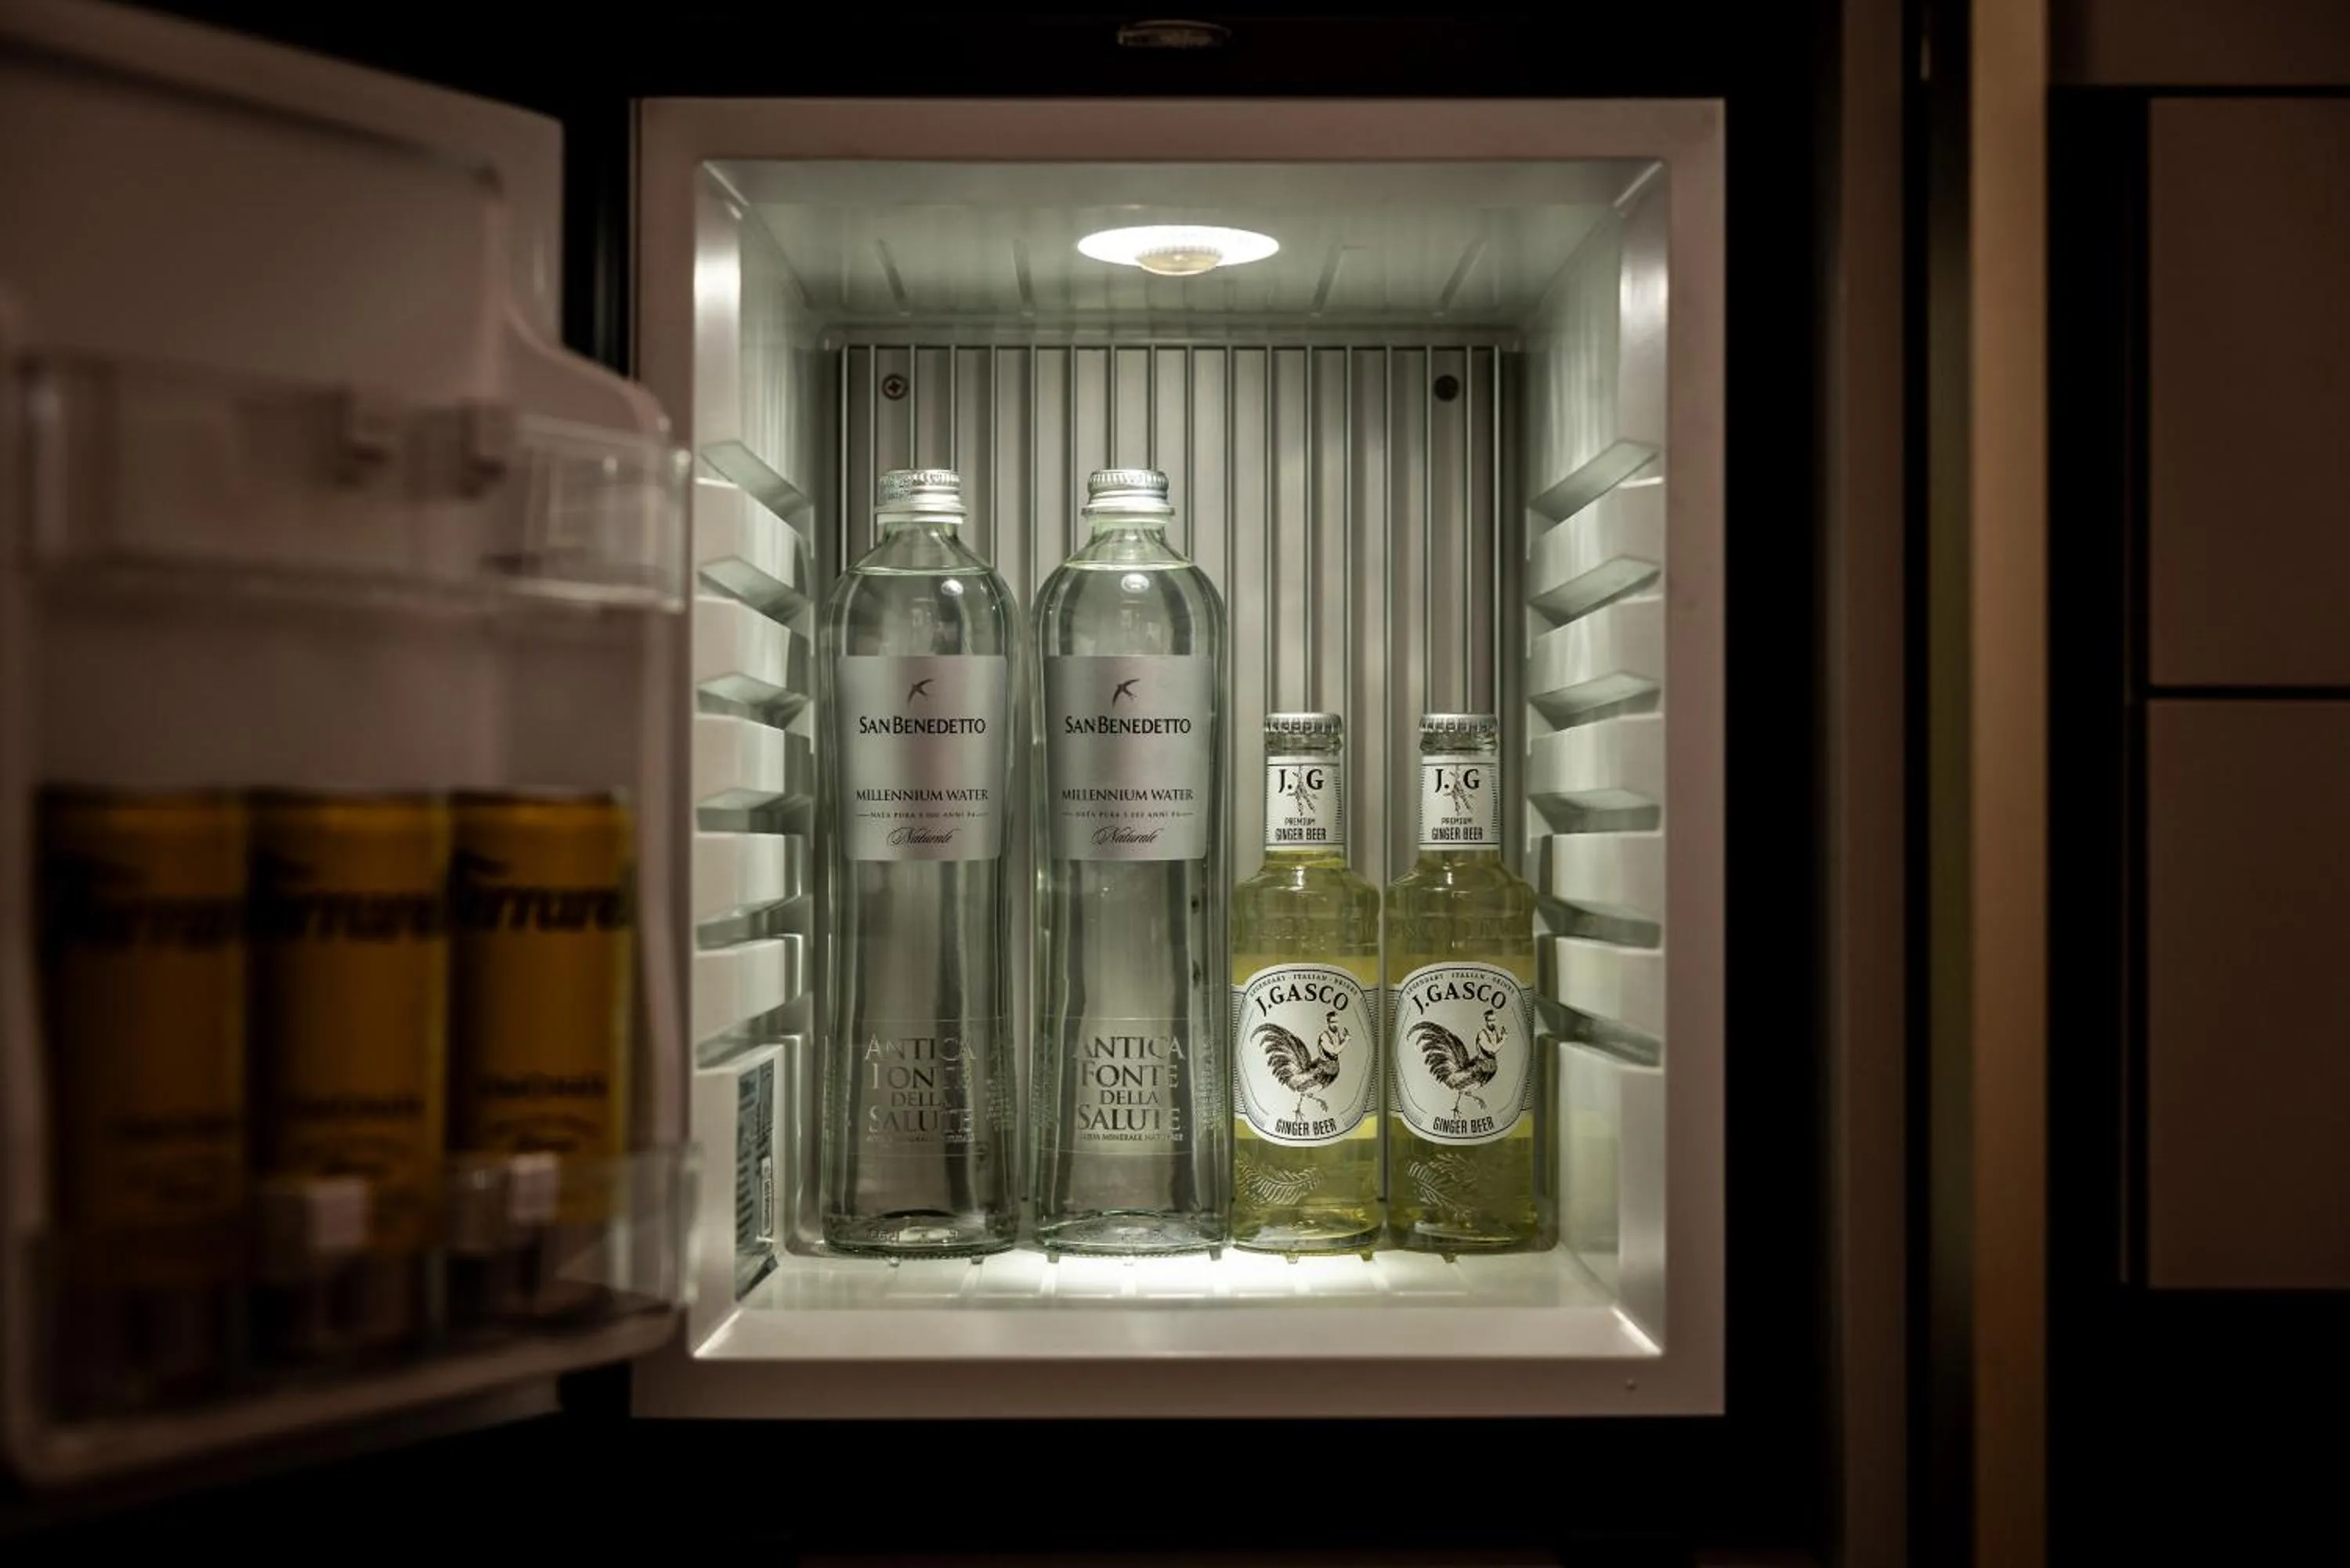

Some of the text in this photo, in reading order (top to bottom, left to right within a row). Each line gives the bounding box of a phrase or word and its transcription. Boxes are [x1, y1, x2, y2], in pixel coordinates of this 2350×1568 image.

[859, 715, 986, 735] SANBENEDETTO
[1065, 715, 1191, 735] SANBENEDETTO
[856, 789, 989, 801] MILLENNIUM WATER
[1061, 789, 1194, 801] MILLENNIUM WATER
[1284, 818, 1316, 826] PREMIUM
[1441, 817, 1473, 826] PREMIUM
[1274, 828, 1326, 840] GINGER BEER
[1431, 827, 1483, 840] GINGER BEER
[1255, 983, 1349, 1017] J.GASCO
[1412, 981, 1506, 1015] J.GASCO
[1075, 1035, 1186, 1060] ANTICA
[1079, 1060, 1179, 1089] FONTE
[1100, 1089, 1161, 1106] DELLA
[1077, 1103, 1181, 1132] SALUTE
[1433, 1116, 1494, 1134] GINGER BEER
[1275, 1118, 1337, 1136] GINGER BEER
